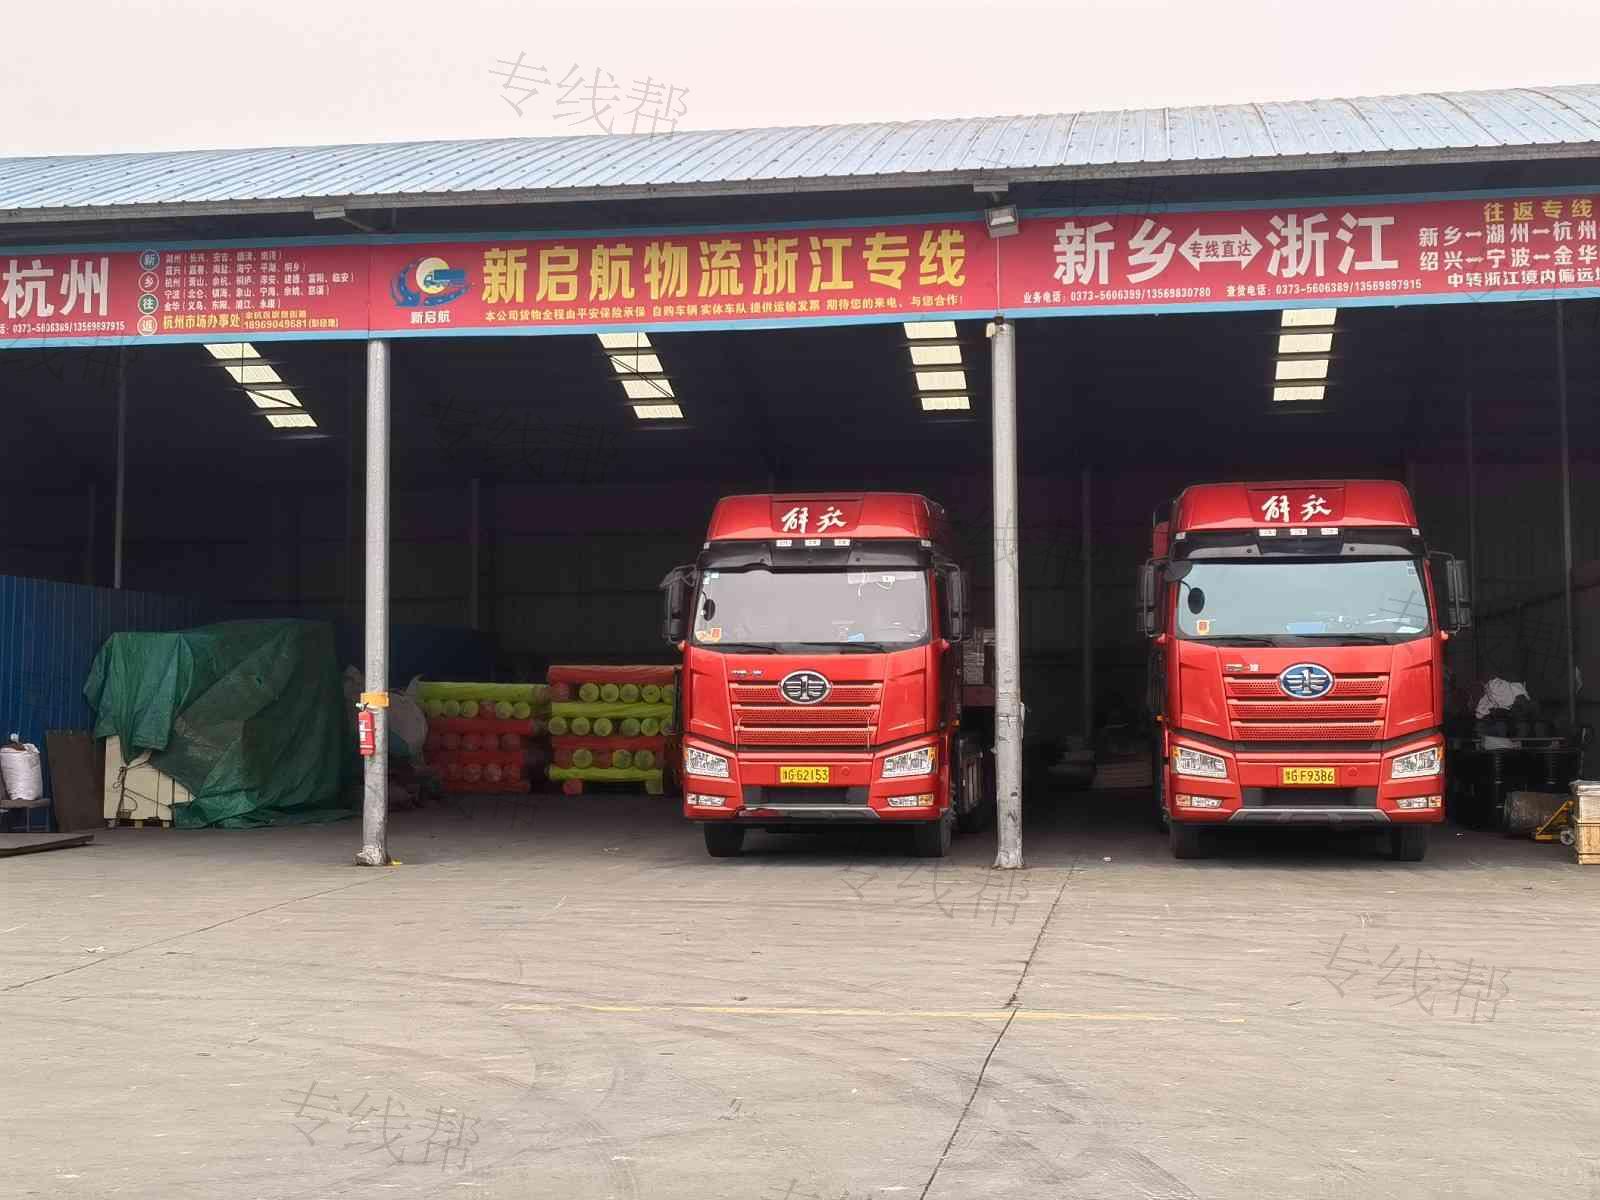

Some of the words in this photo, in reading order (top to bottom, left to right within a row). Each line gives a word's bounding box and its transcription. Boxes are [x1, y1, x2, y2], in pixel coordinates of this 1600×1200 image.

[1484, 199, 1593, 222] 往返专线
[1054, 219, 1176, 284] 新乡
[1188, 240, 1252, 259] 专线直达
[1265, 212, 1399, 278] 浙江
[482, 229, 966, 304] 新启航物流浙江专线
[1, 257, 109, 319] 杭州
[410, 311, 451, 324] 新启航
[781, 506, 848, 534] 解放
[1261, 494, 1332, 523] 解放
